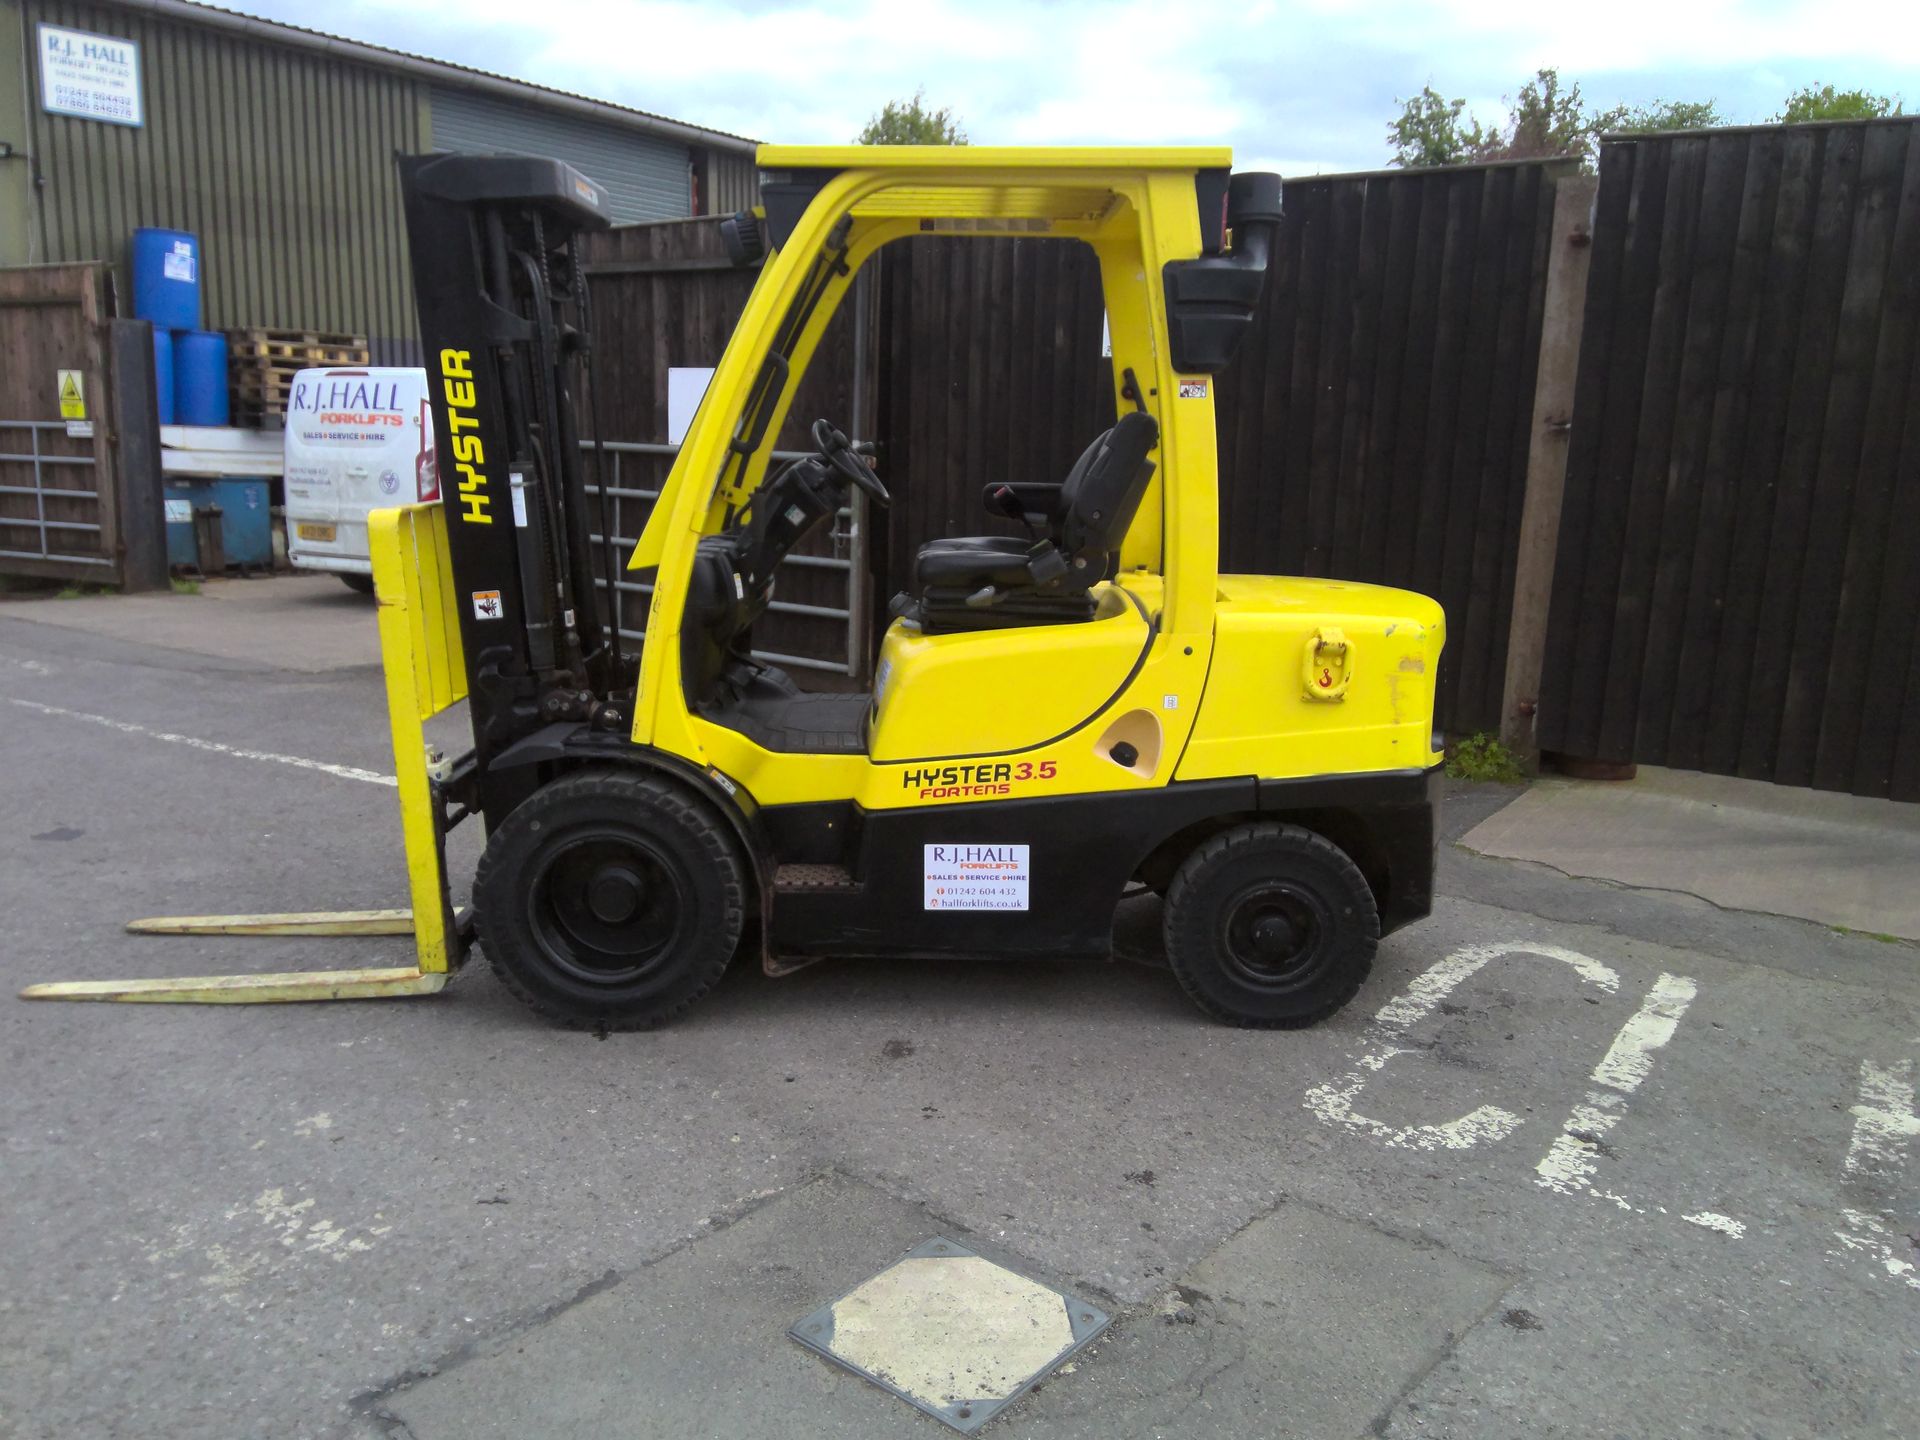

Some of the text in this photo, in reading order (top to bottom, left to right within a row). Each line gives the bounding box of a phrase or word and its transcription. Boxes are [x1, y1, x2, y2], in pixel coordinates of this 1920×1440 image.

[48, 35, 128, 65] R.J. HALL
[320, 412, 404, 427] FORKLIFTS
[303, 431, 385, 440] SALES SERVICE HIRE
[440, 348, 493, 525] HYSTER
[903, 760, 1057, 788] HYSTER 3.5
[920, 783, 1011, 799] FORTENS
[947, 887, 1016, 896] 01242 604 432
[941, 898, 1022, 908] hallforklifts.co.uk
